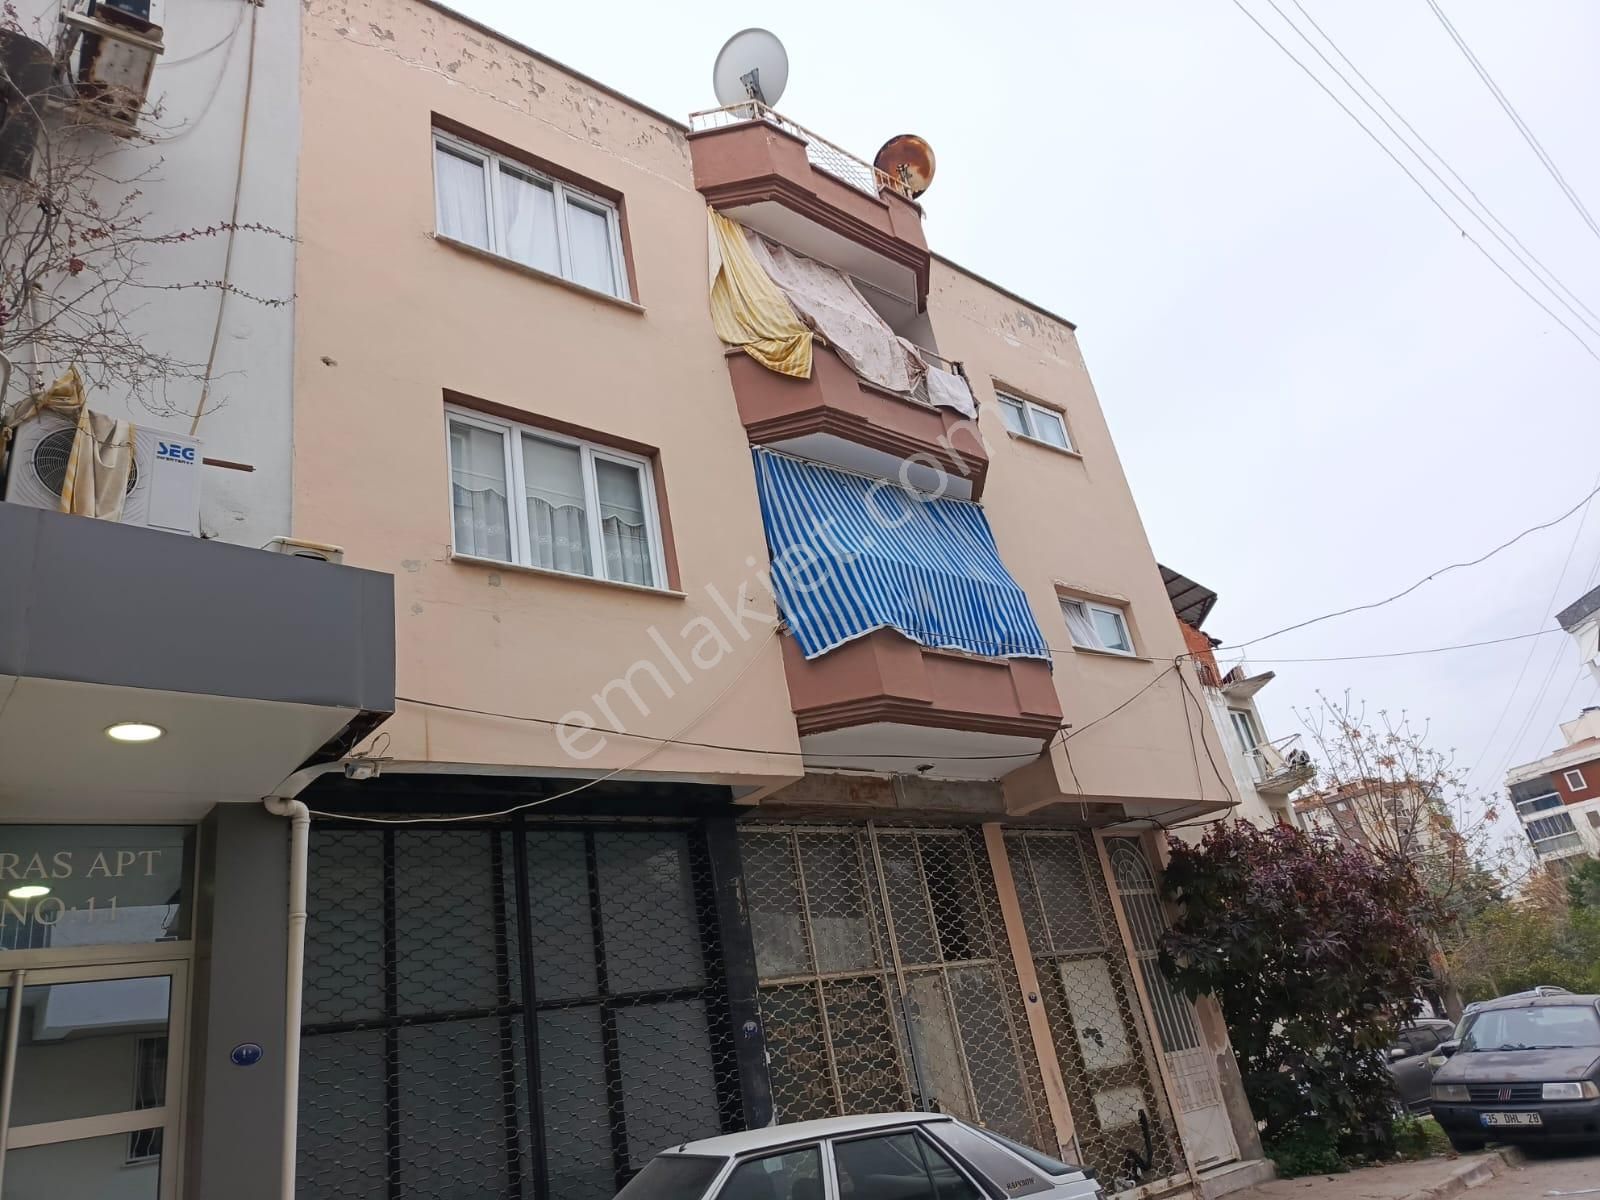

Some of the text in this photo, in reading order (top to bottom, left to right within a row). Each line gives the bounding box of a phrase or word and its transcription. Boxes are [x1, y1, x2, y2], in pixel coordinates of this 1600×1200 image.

[157, 441, 195, 461] SEG
[0, 850, 162, 880] RAS APT
